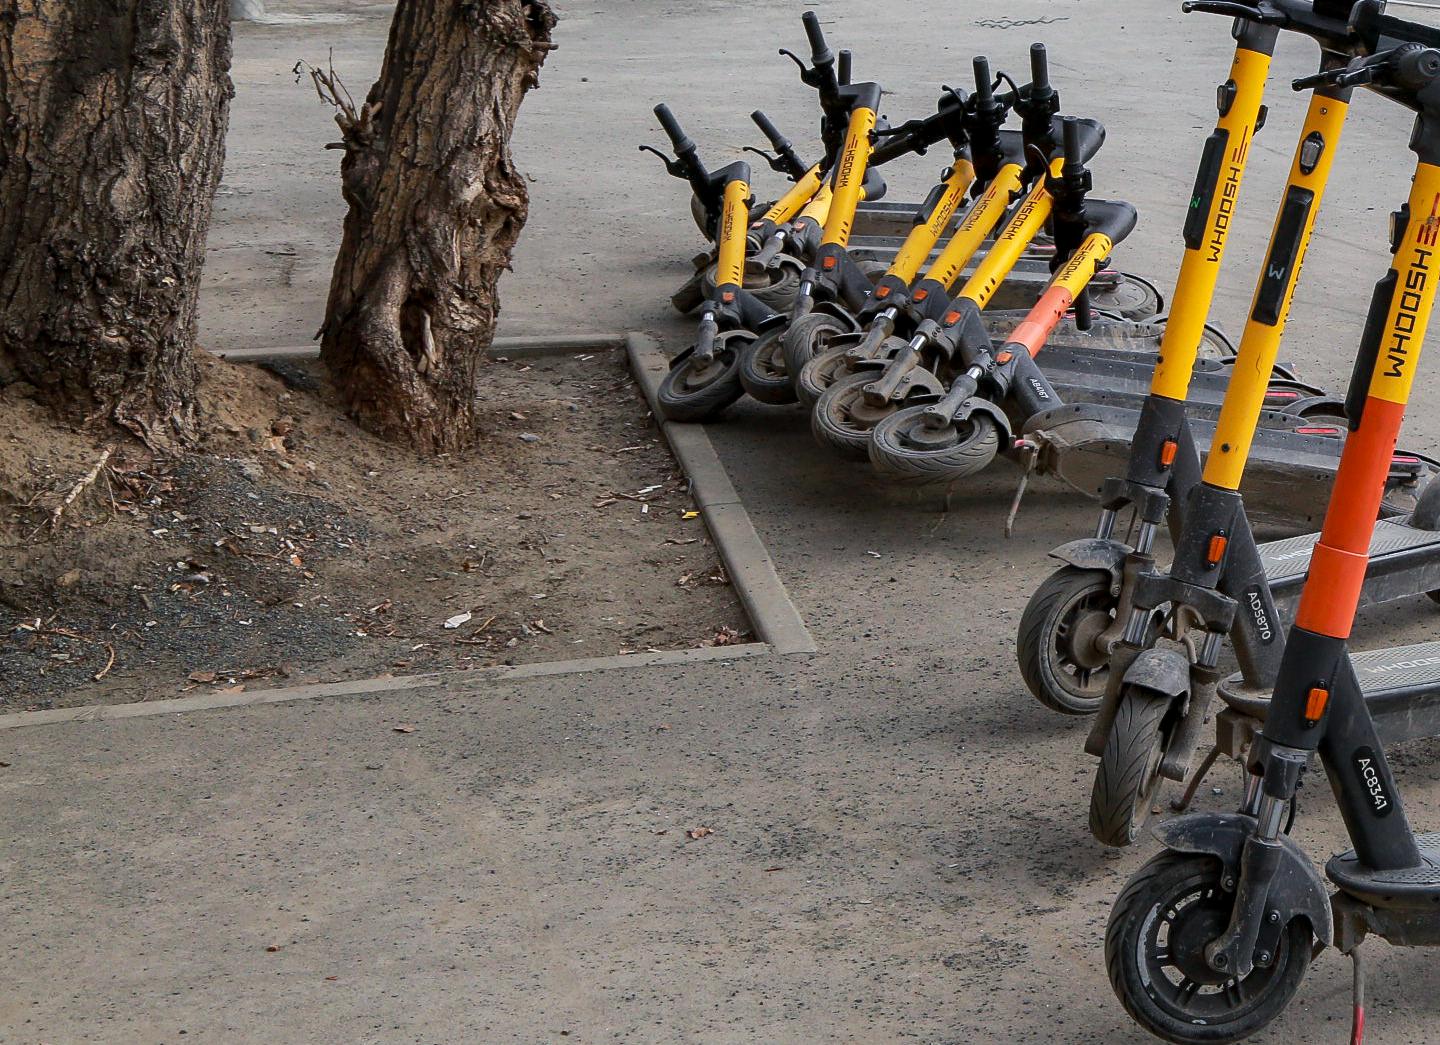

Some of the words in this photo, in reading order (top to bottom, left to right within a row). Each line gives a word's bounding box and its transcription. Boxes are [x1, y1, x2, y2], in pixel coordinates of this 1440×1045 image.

[839, 149, 857, 188] WHOOSH
[929, 199, 954, 238] WHOOSH
[961, 199, 991, 232] WHOOSH
[1002, 201, 1038, 241] WHOOSH
[1207, 167, 1241, 262] WHOOSH
[1057, 250, 1090, 281] WHOOSH
[1384, 248, 1432, 378] WHOOSH
[1248, 592, 1271, 640] AD5870
[1358, 758, 1388, 811] AC8341
